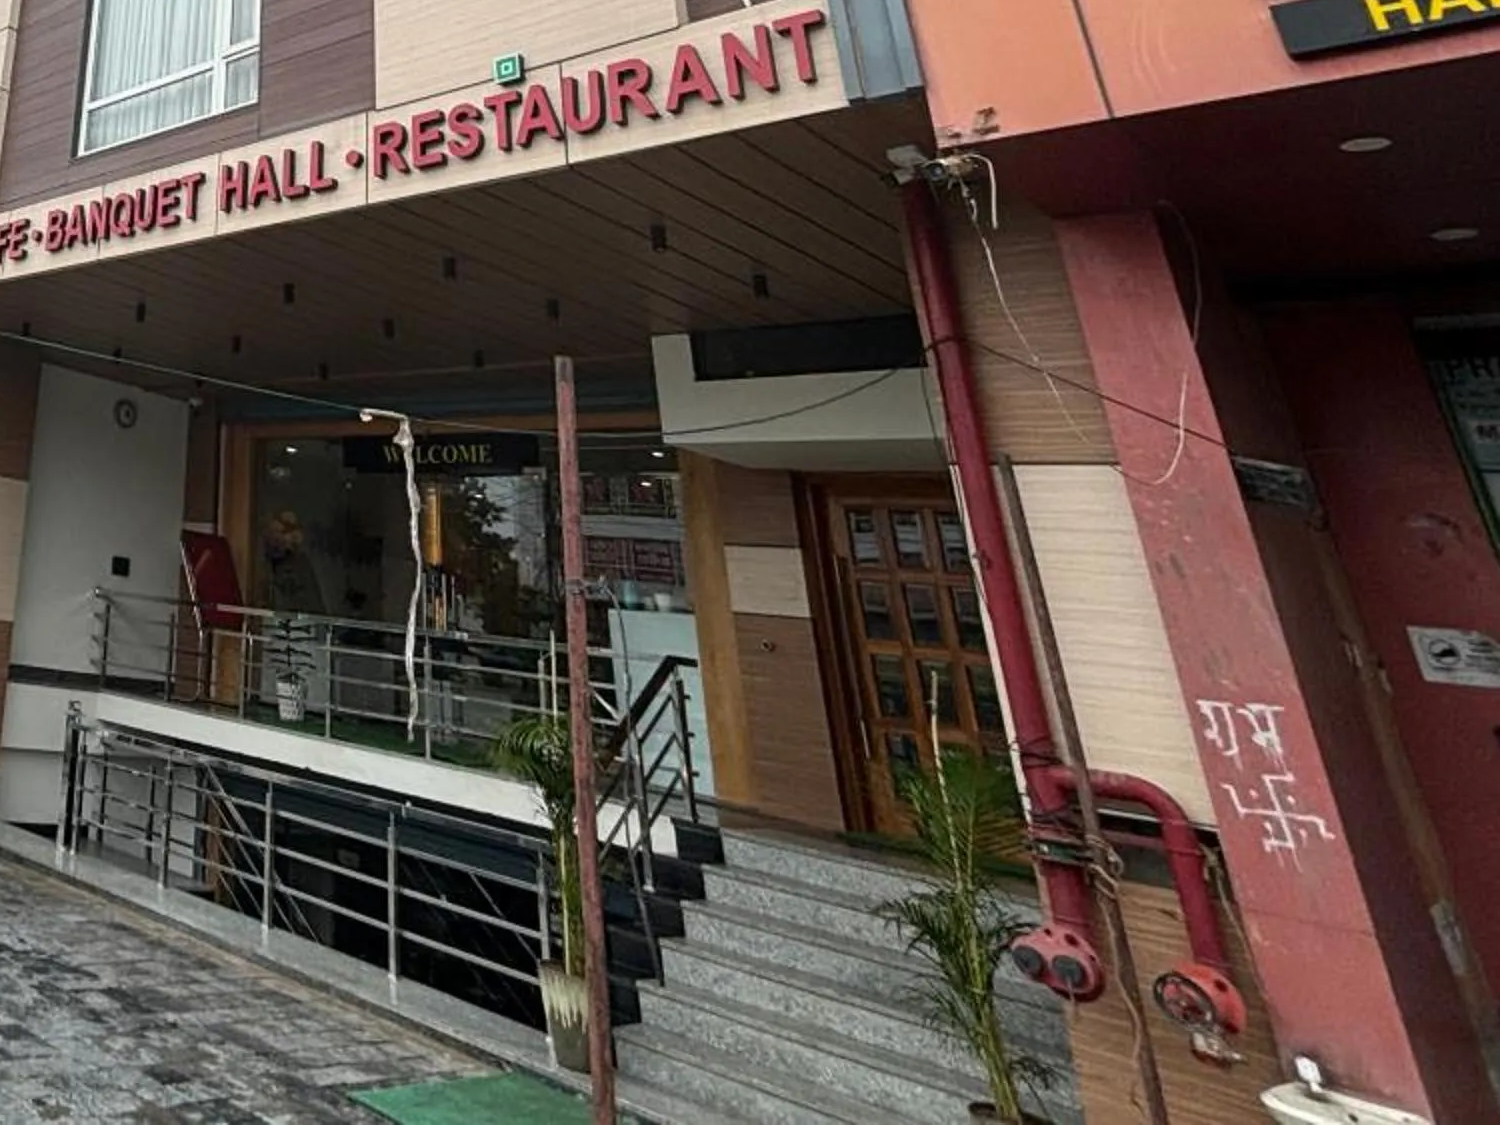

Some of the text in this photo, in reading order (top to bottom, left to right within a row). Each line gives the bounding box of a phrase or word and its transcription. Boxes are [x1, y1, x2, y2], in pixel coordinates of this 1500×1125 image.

[44, 172, 206, 253] BANQUET
[218, 141, 338, 212] HALL
[373, 9, 826, 178] RESTAURANT
[382, 443, 493, 464] WLCOME
